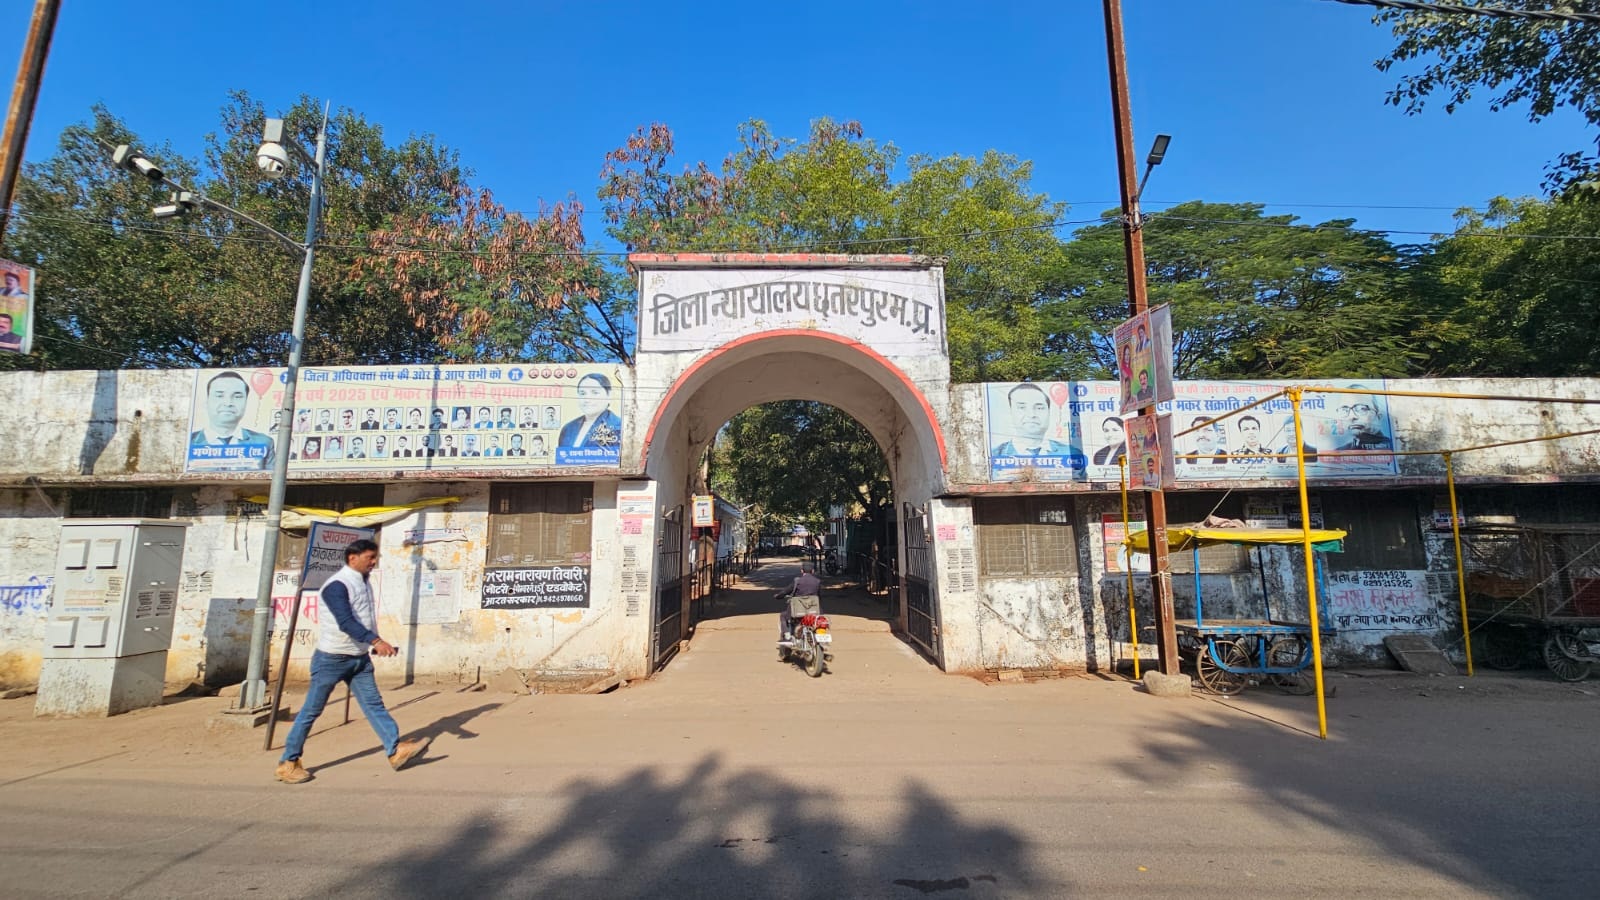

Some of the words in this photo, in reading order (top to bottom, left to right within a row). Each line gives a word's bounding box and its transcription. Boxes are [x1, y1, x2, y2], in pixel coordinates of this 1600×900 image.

[649, 292, 710, 336] जिला
[711, 281, 811, 320] न्यायालय
[304, 369, 329, 382] जिला
[397, 368, 409, 380] की
[412, 368, 430, 380] ओर
[445, 368, 464, 380] आप
[468, 367, 487, 380] सभी
[490, 367, 502, 379] को
[306, 385, 326, 401] वर्ष
[328, 388, 366, 402] 2025
[1068, 400, 1094, 416] नूतन
[1097, 396, 1115, 412] वर्ष
[1176, 399, 1201, 412] मकर
[192, 446, 223, 457] गणेश
[224, 447, 248, 459] साहू
[553, 566, 583, 581] तिवारी
